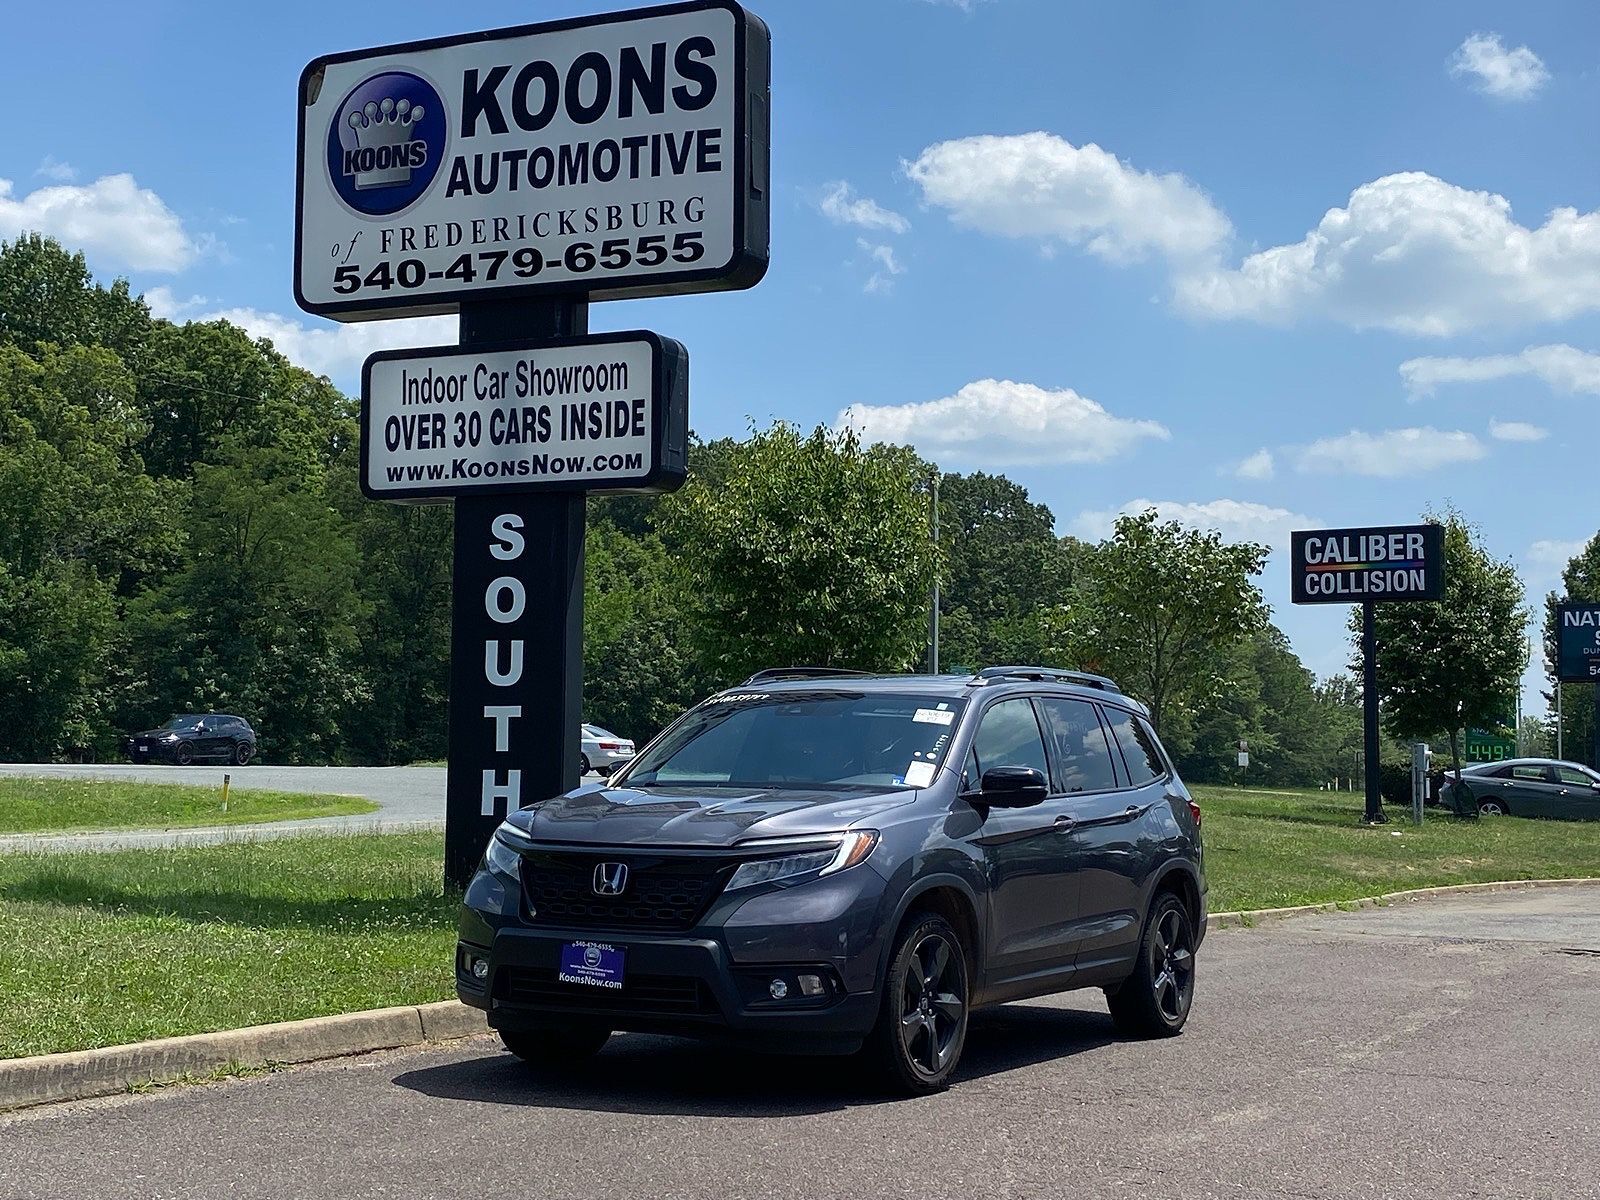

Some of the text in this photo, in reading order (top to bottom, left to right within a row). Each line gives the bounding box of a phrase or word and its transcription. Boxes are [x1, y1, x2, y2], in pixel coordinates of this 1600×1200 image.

[460, 36, 718, 138] KOONS
[343, 141, 427, 174] KOONS
[445, 128, 722, 198] AUTOMOTIVE
[331, 196, 705, 264] of FREDERICKSBURG
[332, 231, 706, 294] 540-479-6555
[402, 359, 629, 405] Indoor Car Showroom
[385, 398, 646, 452] OVER 30 CARS INSIDE
[1304, 533, 1425, 564] CALIBER
[1305, 569, 1426, 595] COLLISION
[480, 513, 526, 816] SOUTH
[559, 972, 622, 989] KoonsNow.com
